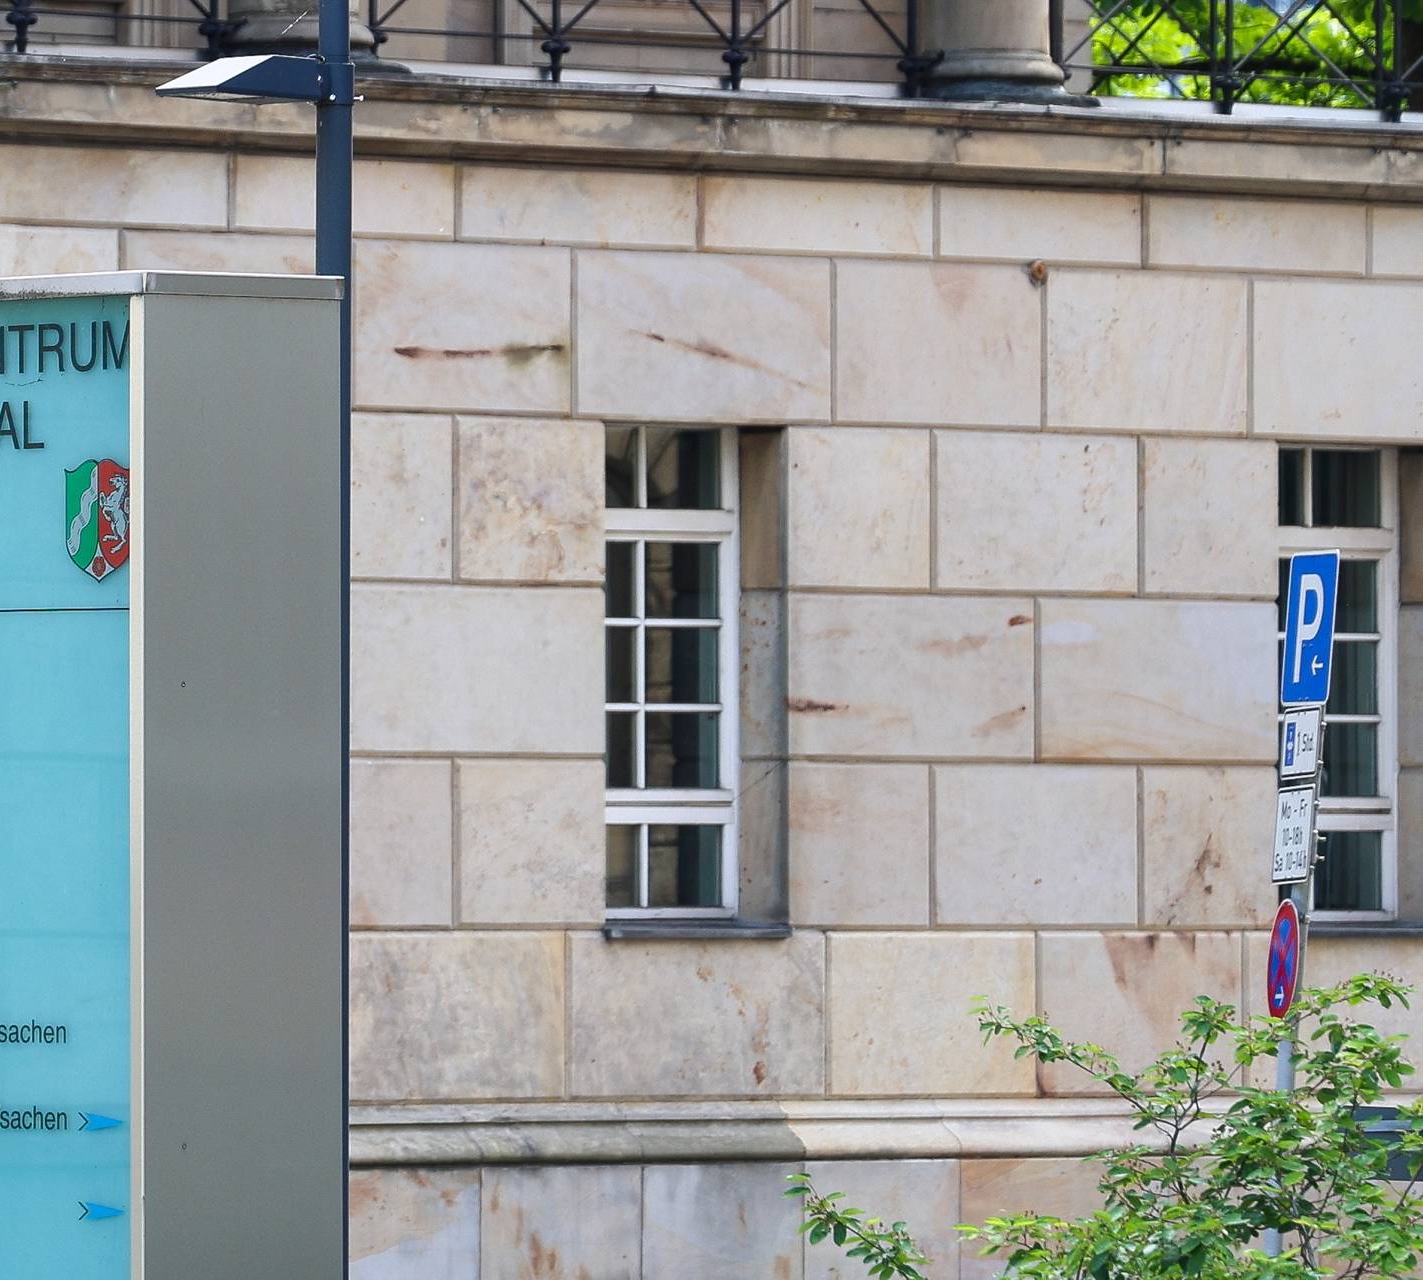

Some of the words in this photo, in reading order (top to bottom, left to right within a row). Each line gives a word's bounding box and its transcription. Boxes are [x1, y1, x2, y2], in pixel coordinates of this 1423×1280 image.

[1293, 573, 1325, 684] P
[1280, 800, 1292, 820] Mo
[1298, 798, 1308, 818] Fr
[1274, 852, 1284, 872] Sa
